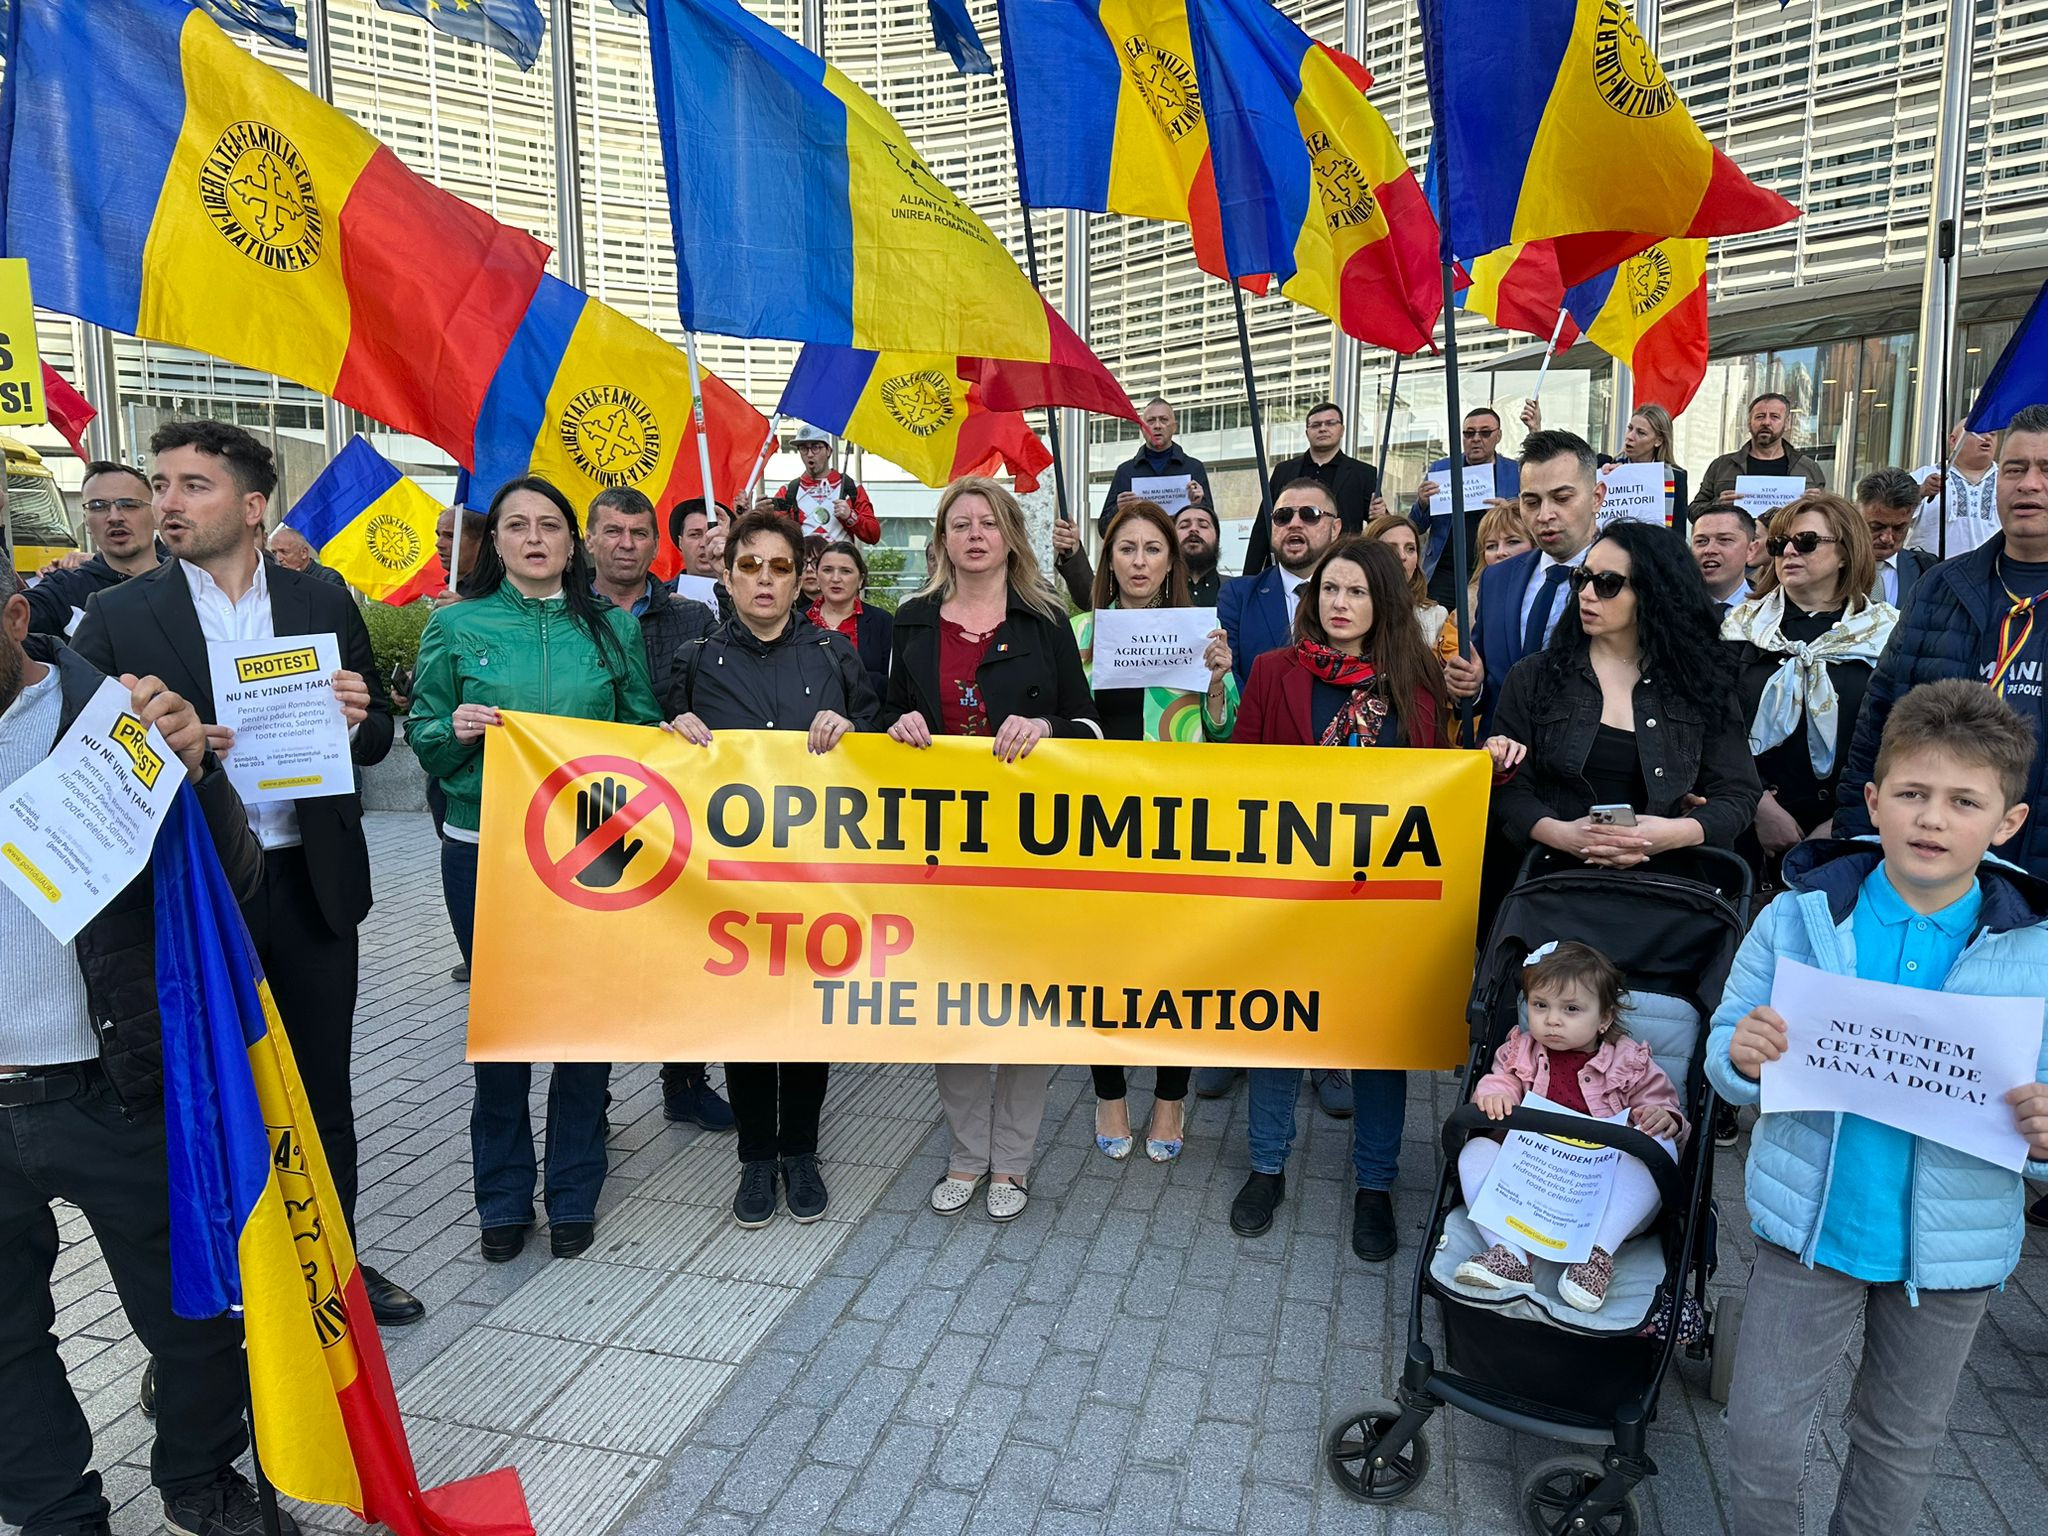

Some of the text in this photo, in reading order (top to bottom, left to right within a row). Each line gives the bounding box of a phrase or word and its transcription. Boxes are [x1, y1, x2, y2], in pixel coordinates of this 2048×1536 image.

[1605, 76, 1674, 115] NATIUNE
[201, 124, 321, 270] LIBERTATEA FAMILIA CREDINTA NATIUNEA
[891, 208, 932, 222] UNIREA
[561, 387, 659, 487] LIBERTATEA FAMILIA CREDINTA NATIUNEA
[1601, 496, 1654, 507] ORTATORII
[1608, 485, 1643, 494] UMILIȚI
[1131, 634, 1178, 644] SALVAȚI
[242, 653, 311, 676] PROTEST
[1113, 657, 1193, 667] ROMÂNEASCĂ!
[226, 693, 241, 702] NU
[244, 690, 259, 699] NE
[261, 683, 303, 696] VINDEM
[237, 706, 264, 714] Pentru
[241, 715, 268, 724] pentru
[298, 709, 325, 718] pentru
[237, 720, 293, 733] Hidroelectrica,
[255, 728, 314, 740] toate celelalte!
[81, 735, 101, 751] NU
[100, 748, 115, 764] NE
[80, 756, 105, 782] Pentru
[58, 773, 107, 825] Hidroelectrica,
[106, 822, 129, 848] Salrom
[72, 769, 99, 795] pentru
[115, 816, 136, 841] pentru
[13, 806, 24, 819] Mai
[22, 816, 39, 832] 2023
[62, 797, 85, 820] toate
[82, 818, 115, 850] celelalte!
[707, 783, 1442, 895] OPRIȚI UMILINȚA
[703, 910, 915, 978] STOP
[813, 980, 1320, 1032] THE HUMILIATION
[1829, 1020, 1975, 1060] NU SUNTEM
[1816, 1037, 1982, 1083] CETĂȚENI DE
[1805, 1053, 1987, 1106] MÂNA A DOUA!
[1518, 1135, 1533, 1146] NU
[1534, 1142, 1549, 1152] NE
[1551, 1148, 1592, 1165] VINDEM
[1521, 1150, 1547, 1166] Pentru
[1512, 1163, 1566, 1193] Hidroelectrica,
[1520, 1159, 1547, 1175] pentru
[1525, 1179, 1547, 1193] toate
